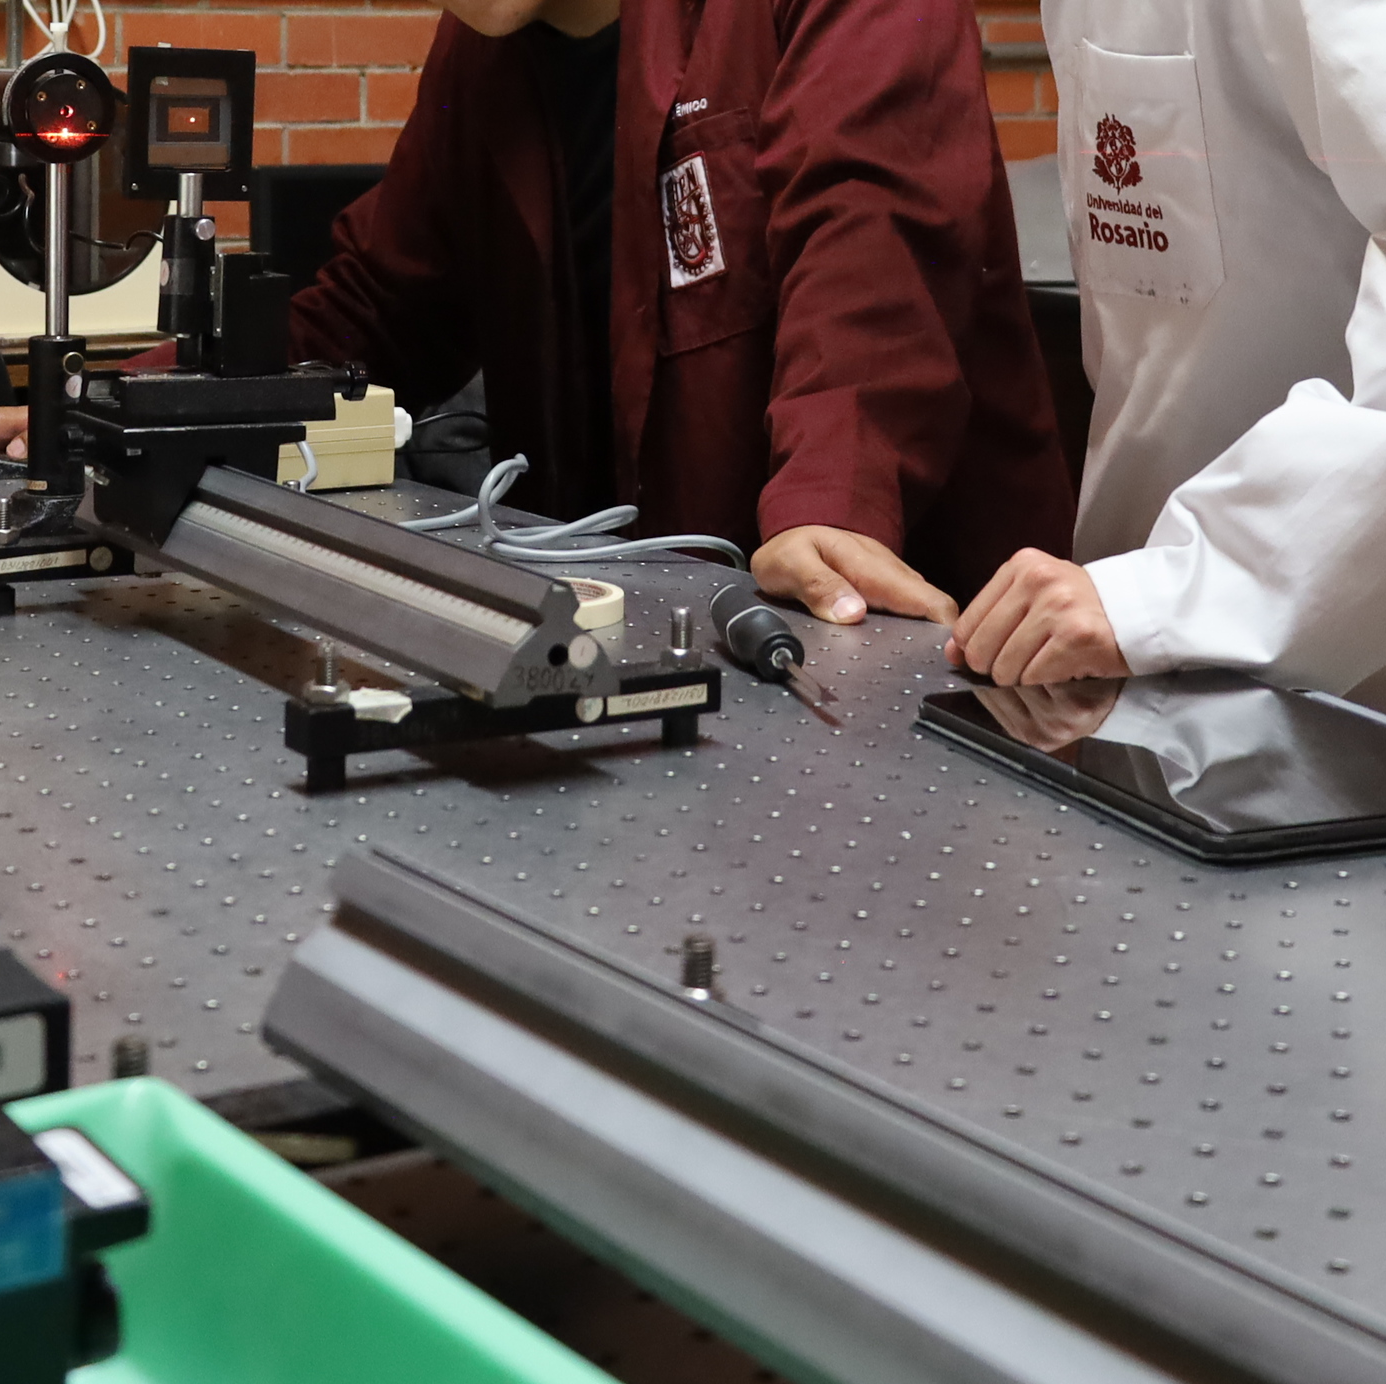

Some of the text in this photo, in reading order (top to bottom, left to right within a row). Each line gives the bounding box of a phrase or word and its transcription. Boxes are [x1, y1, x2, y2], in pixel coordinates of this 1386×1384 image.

[1086, 192, 1164, 220] Universidad del
[1088, 212, 1170, 253] Rosario
